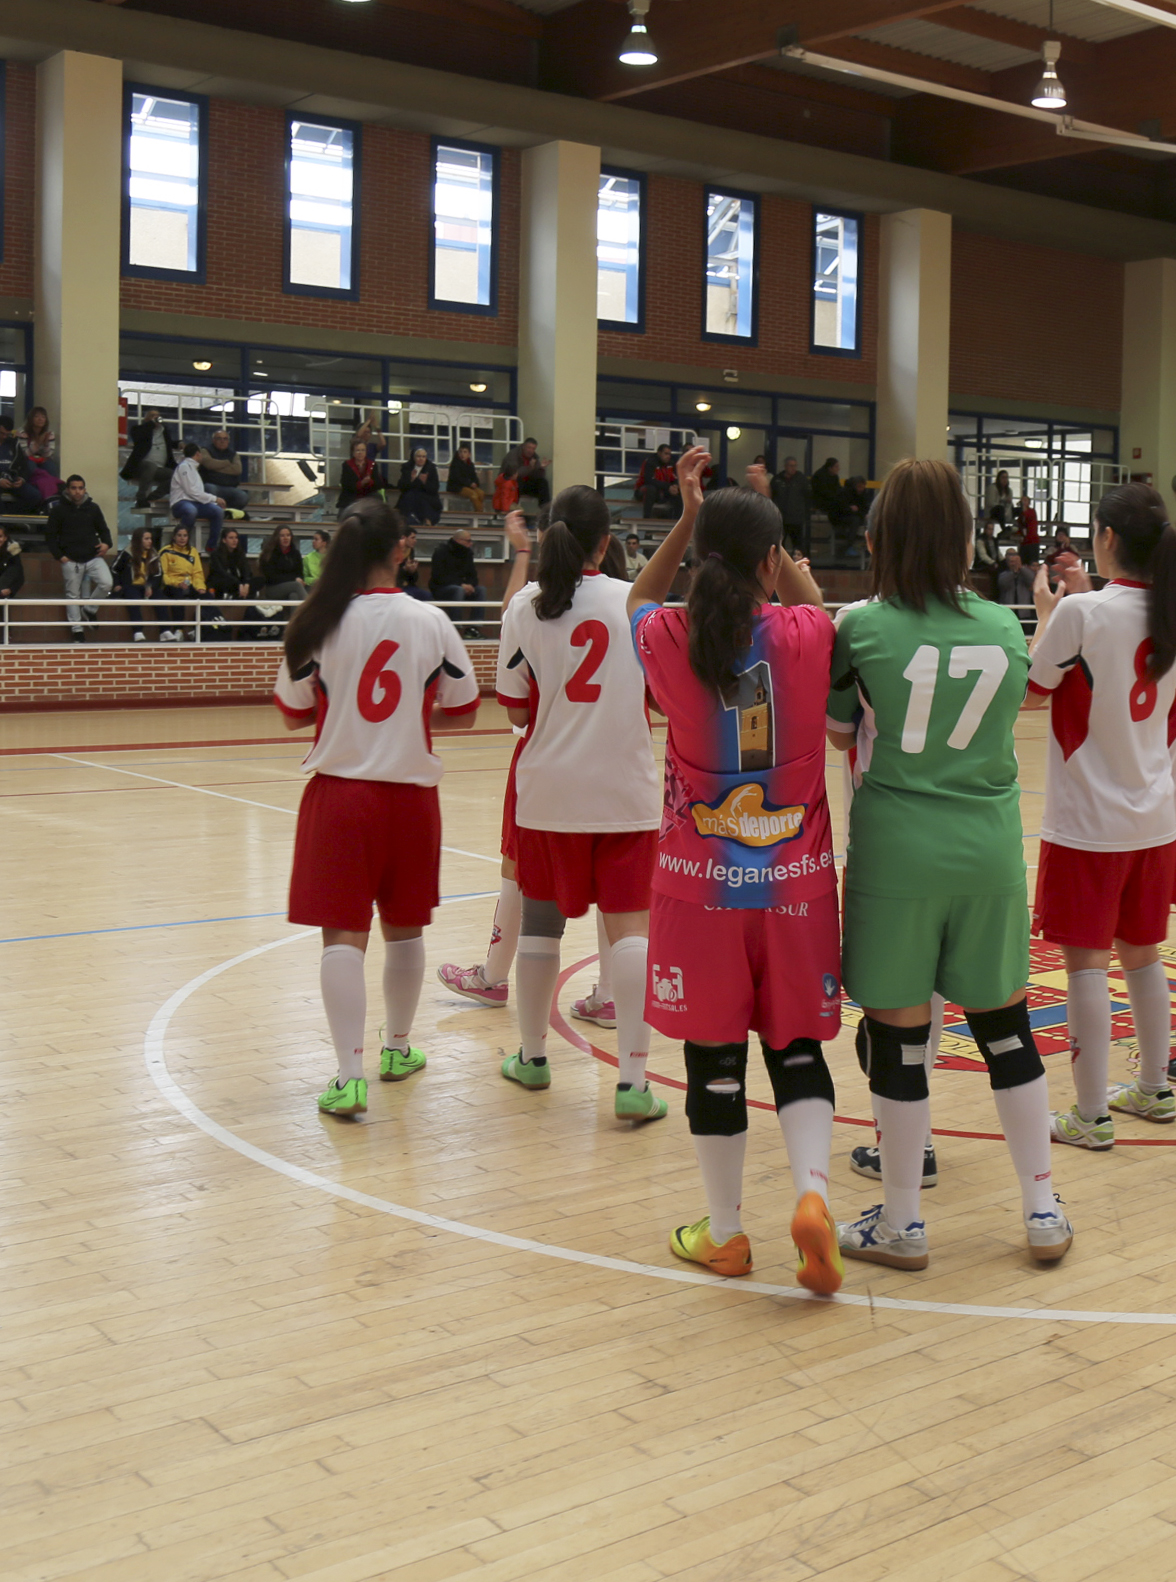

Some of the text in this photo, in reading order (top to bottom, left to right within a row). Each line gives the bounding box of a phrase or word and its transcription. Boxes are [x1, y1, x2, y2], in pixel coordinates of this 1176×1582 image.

[357, 639, 402, 723] 6
[564, 619, 610, 703] 2
[900, 645, 1009, 753] 17
[659, 849, 832, 888] www.leganesfs.es
